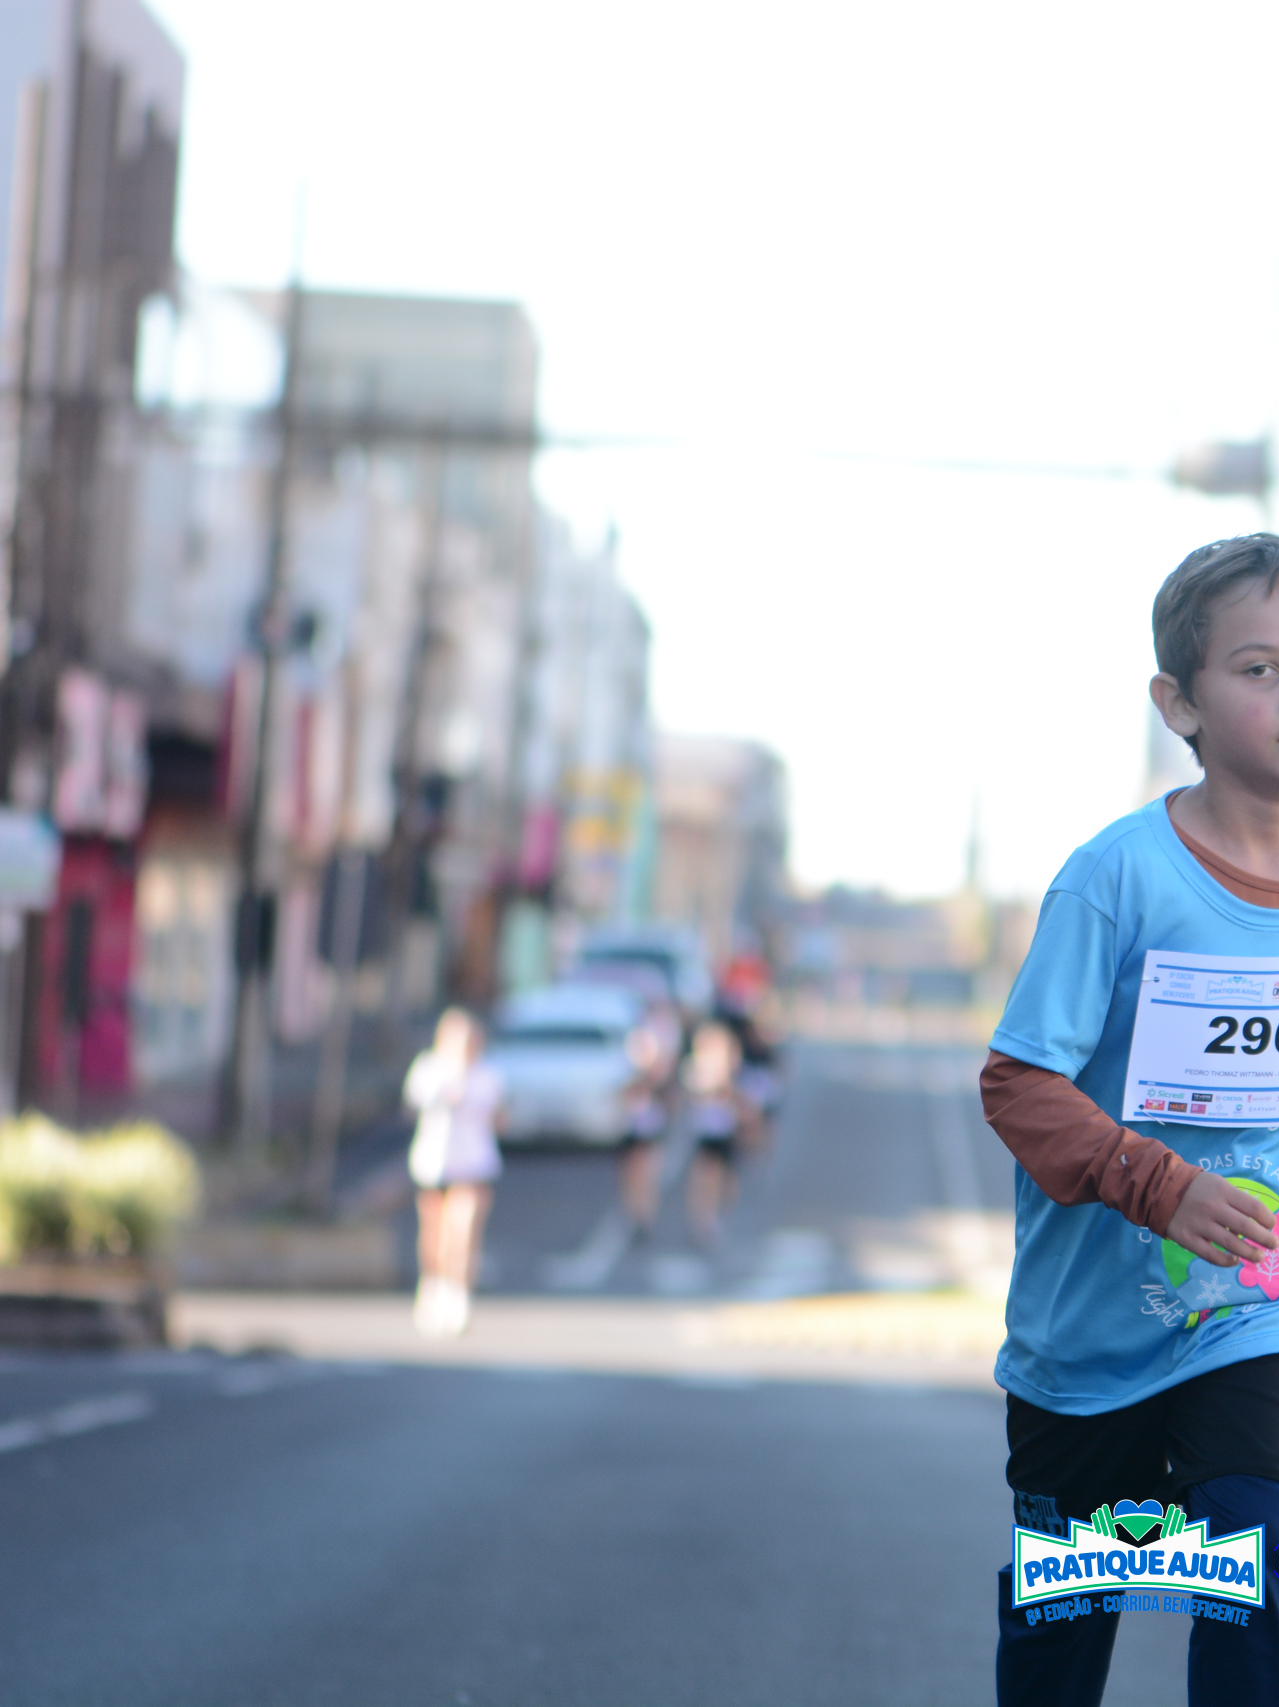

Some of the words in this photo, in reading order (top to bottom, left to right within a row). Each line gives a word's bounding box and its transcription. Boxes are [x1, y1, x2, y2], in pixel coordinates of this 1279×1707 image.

[1241, 988, 1261, 996] AJUDA
[1185, 1068, 1209, 1077] PEDRO
[1158, 1090, 1185, 1099] Sicredi
[1198, 1153, 1234, 1172] DAS
[1140, 1284, 1185, 1328] Night
